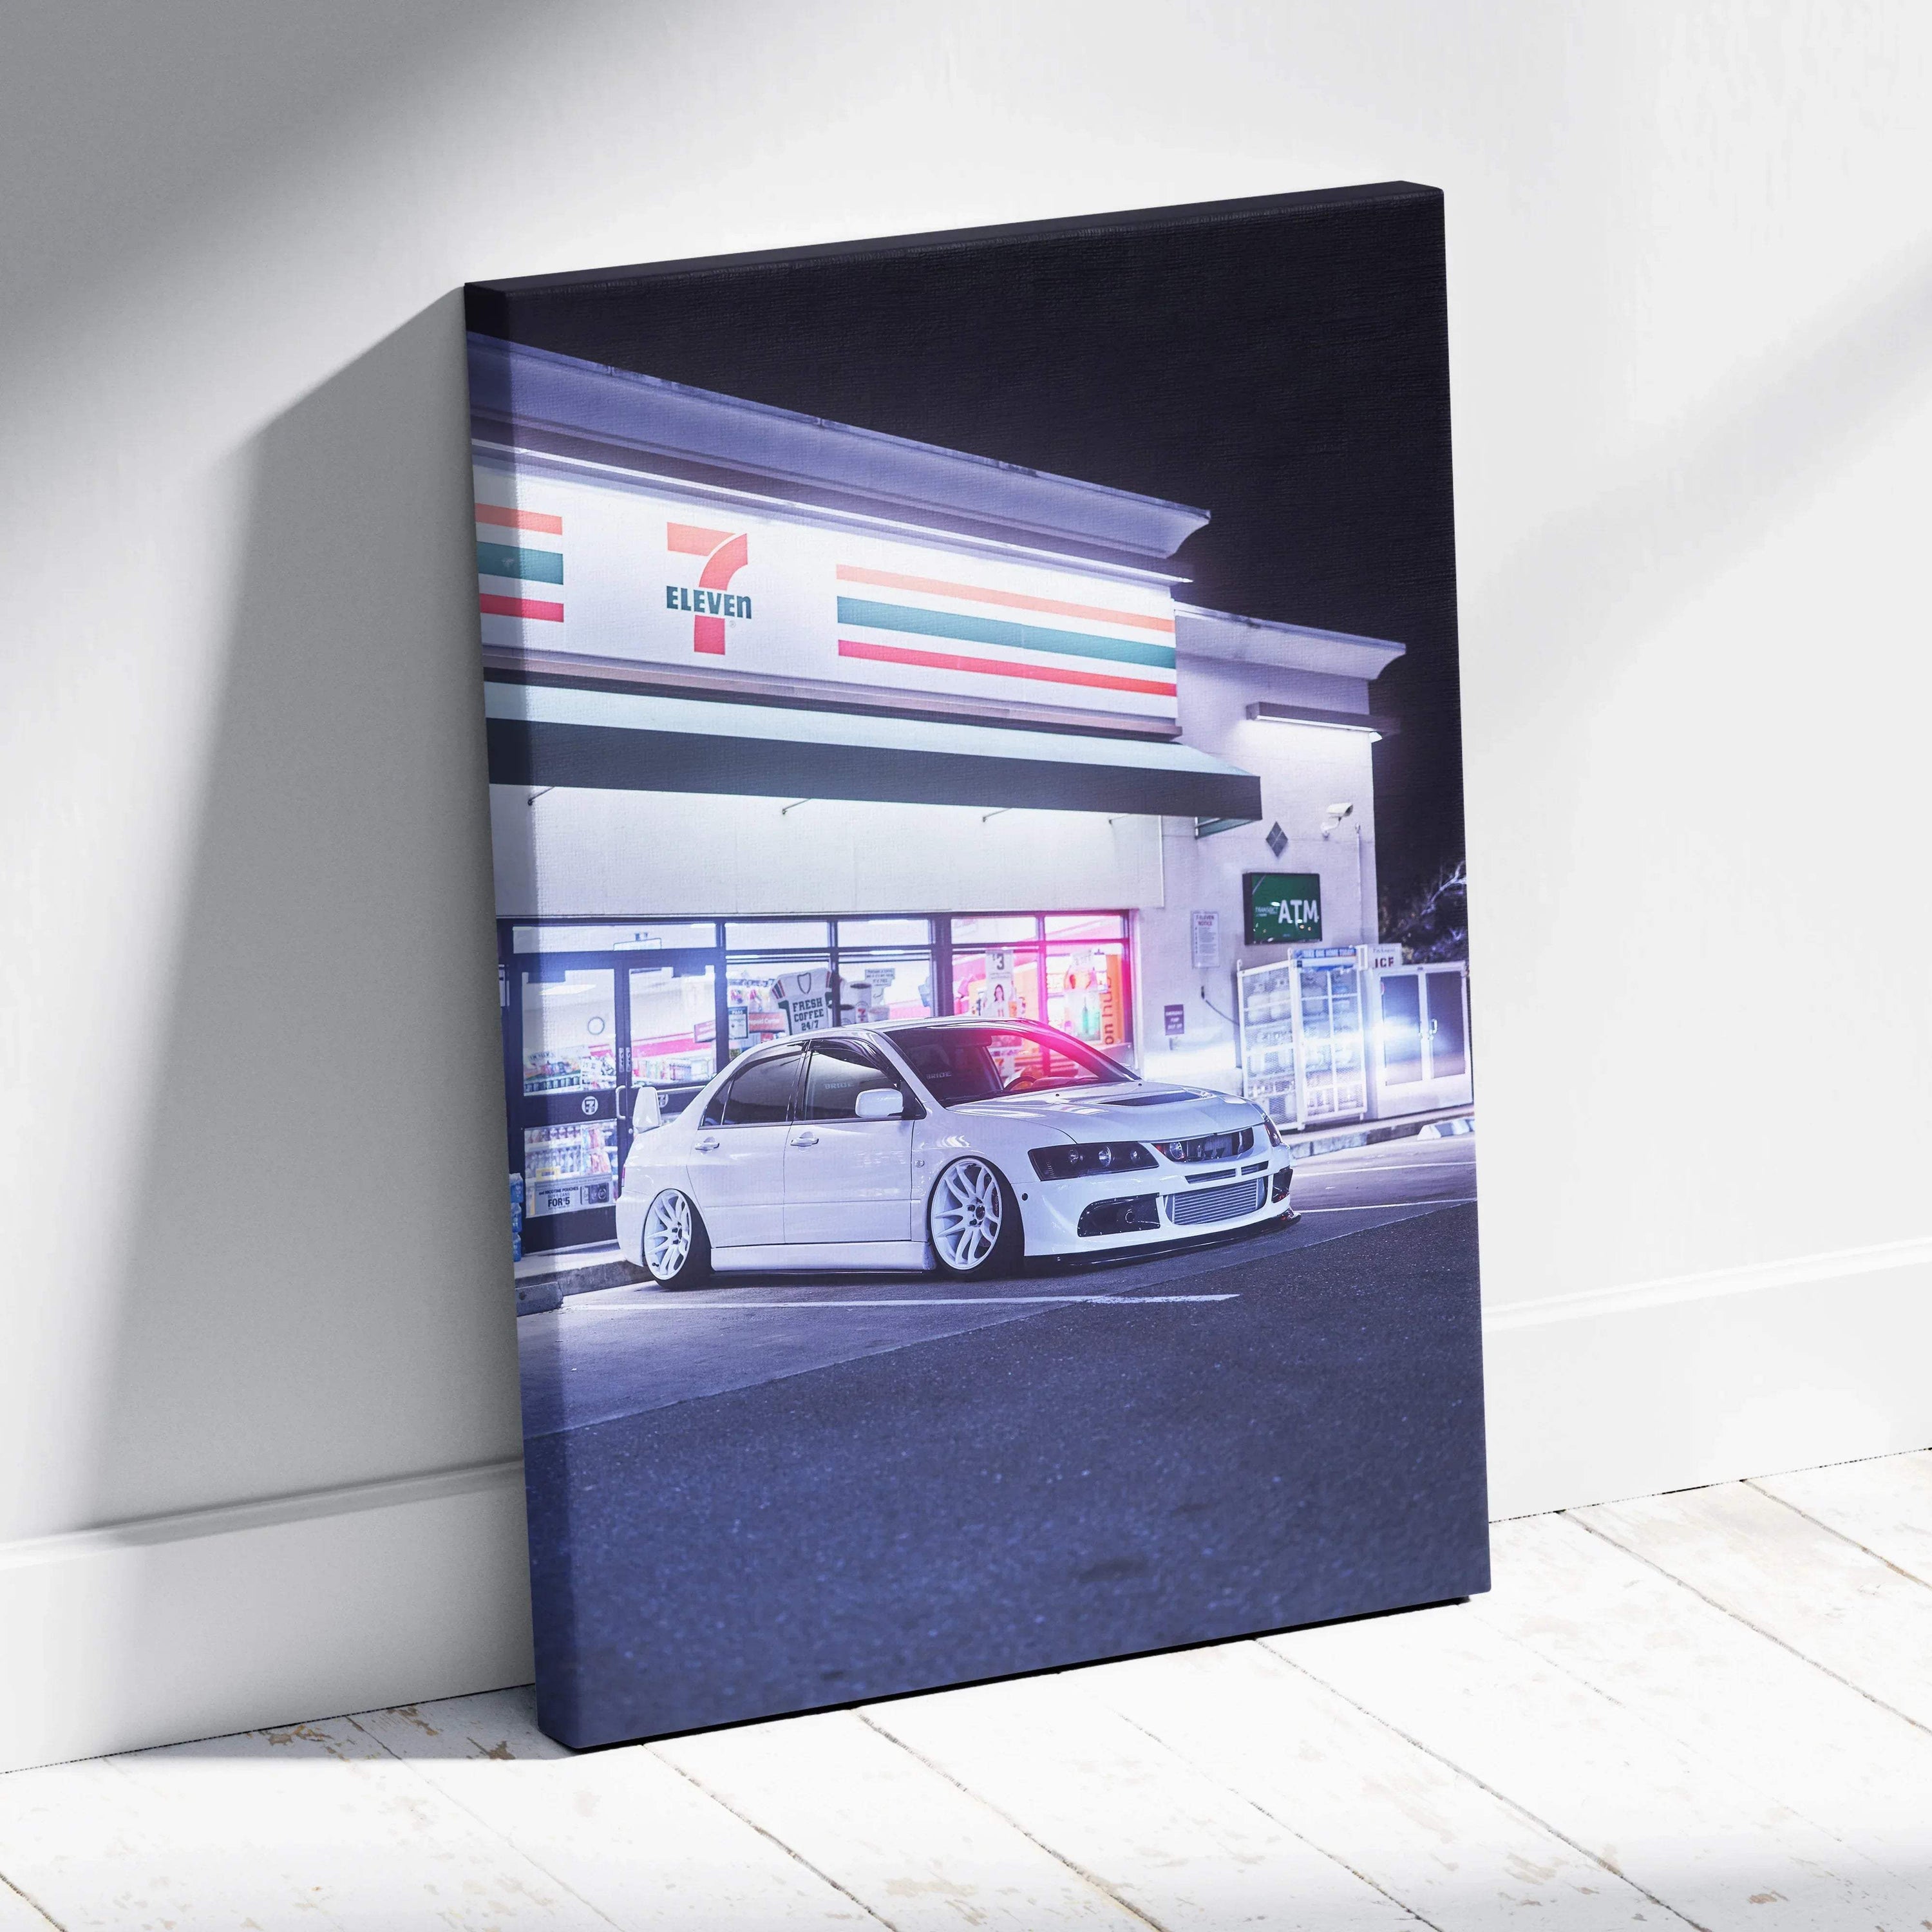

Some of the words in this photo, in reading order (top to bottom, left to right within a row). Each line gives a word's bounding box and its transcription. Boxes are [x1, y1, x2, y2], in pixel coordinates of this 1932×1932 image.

[667, 522, 748, 656] 7
[1278, 899, 1319, 924] ATM
[792, 998, 823, 1012] FRESH
[793, 1009, 824, 1023] COFFEE
[801, 1020, 819, 1031] 24/7
[925, 1070, 952, 1079] BRIDE
[548, 1198, 563, 1208] FOR
